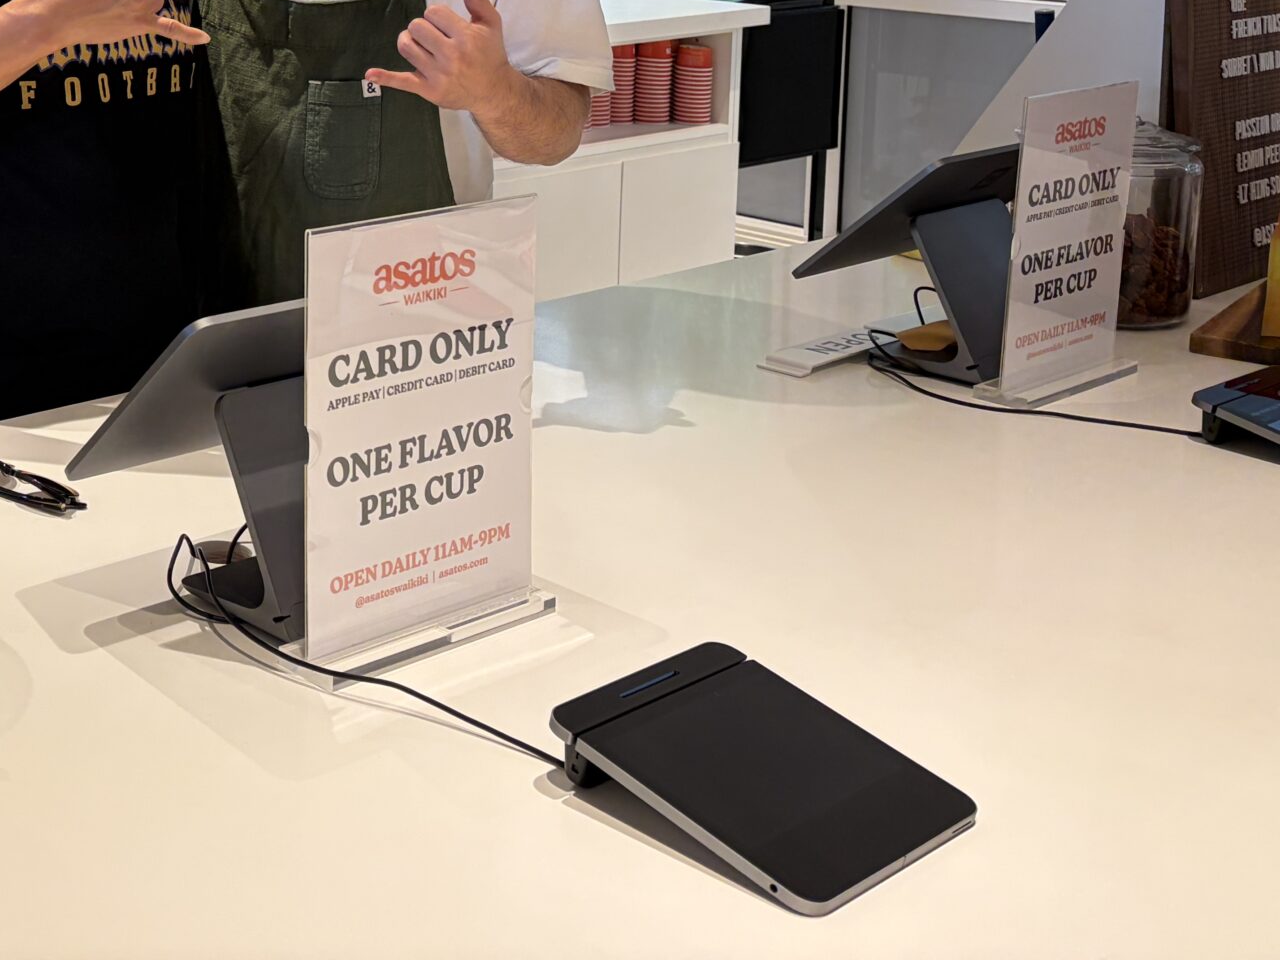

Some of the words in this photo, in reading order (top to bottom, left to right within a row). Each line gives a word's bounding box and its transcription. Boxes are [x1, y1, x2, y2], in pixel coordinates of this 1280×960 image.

[1231, 16, 1262, 39] FRENCH
[1055, 116, 1106, 144] asatos
[1235, 114, 1270, 140] PASSION
[1236, 147, 1265, 173] LEMON
[1028, 177, 1075, 207] CARD
[1078, 166, 1121, 196] ONLY
[372, 249, 477, 295] asatos
[1021, 248, 1054, 277] ONE
[1055, 233, 1114, 267] FLAVOR
[403, 287, 448, 306] WAIKIKI
[1033, 279, 1063, 305] PER
[1066, 268, 1098, 294] CUP
[327, 339, 423, 388] CARD
[429, 318, 515, 365] ONLY
[1015, 329, 1041, 349] OPEN
[1040, 322, 1067, 342] DAILY
[327, 393, 361, 411] APPLE
[362, 388, 382, 403] PAY
[386, 378, 424, 396] CREDIT
[425, 372, 453, 387] CARD
[458, 364, 487, 380] DEBIT
[488, 357, 515, 372] CARD
[326, 441, 393, 488] ONE
[398, 412, 514, 470] FLAVOR
[359, 483, 419, 526] PER
[423, 464, 485, 505] CUP
[329, 564, 379, 595] OPEN
[381, 547, 432, 578] DAILY
[433, 522, 511, 562] 11AM-9PM
[355, 573, 429, 609] @asatoswaikiki
[438, 556, 489, 579] asatos.com
